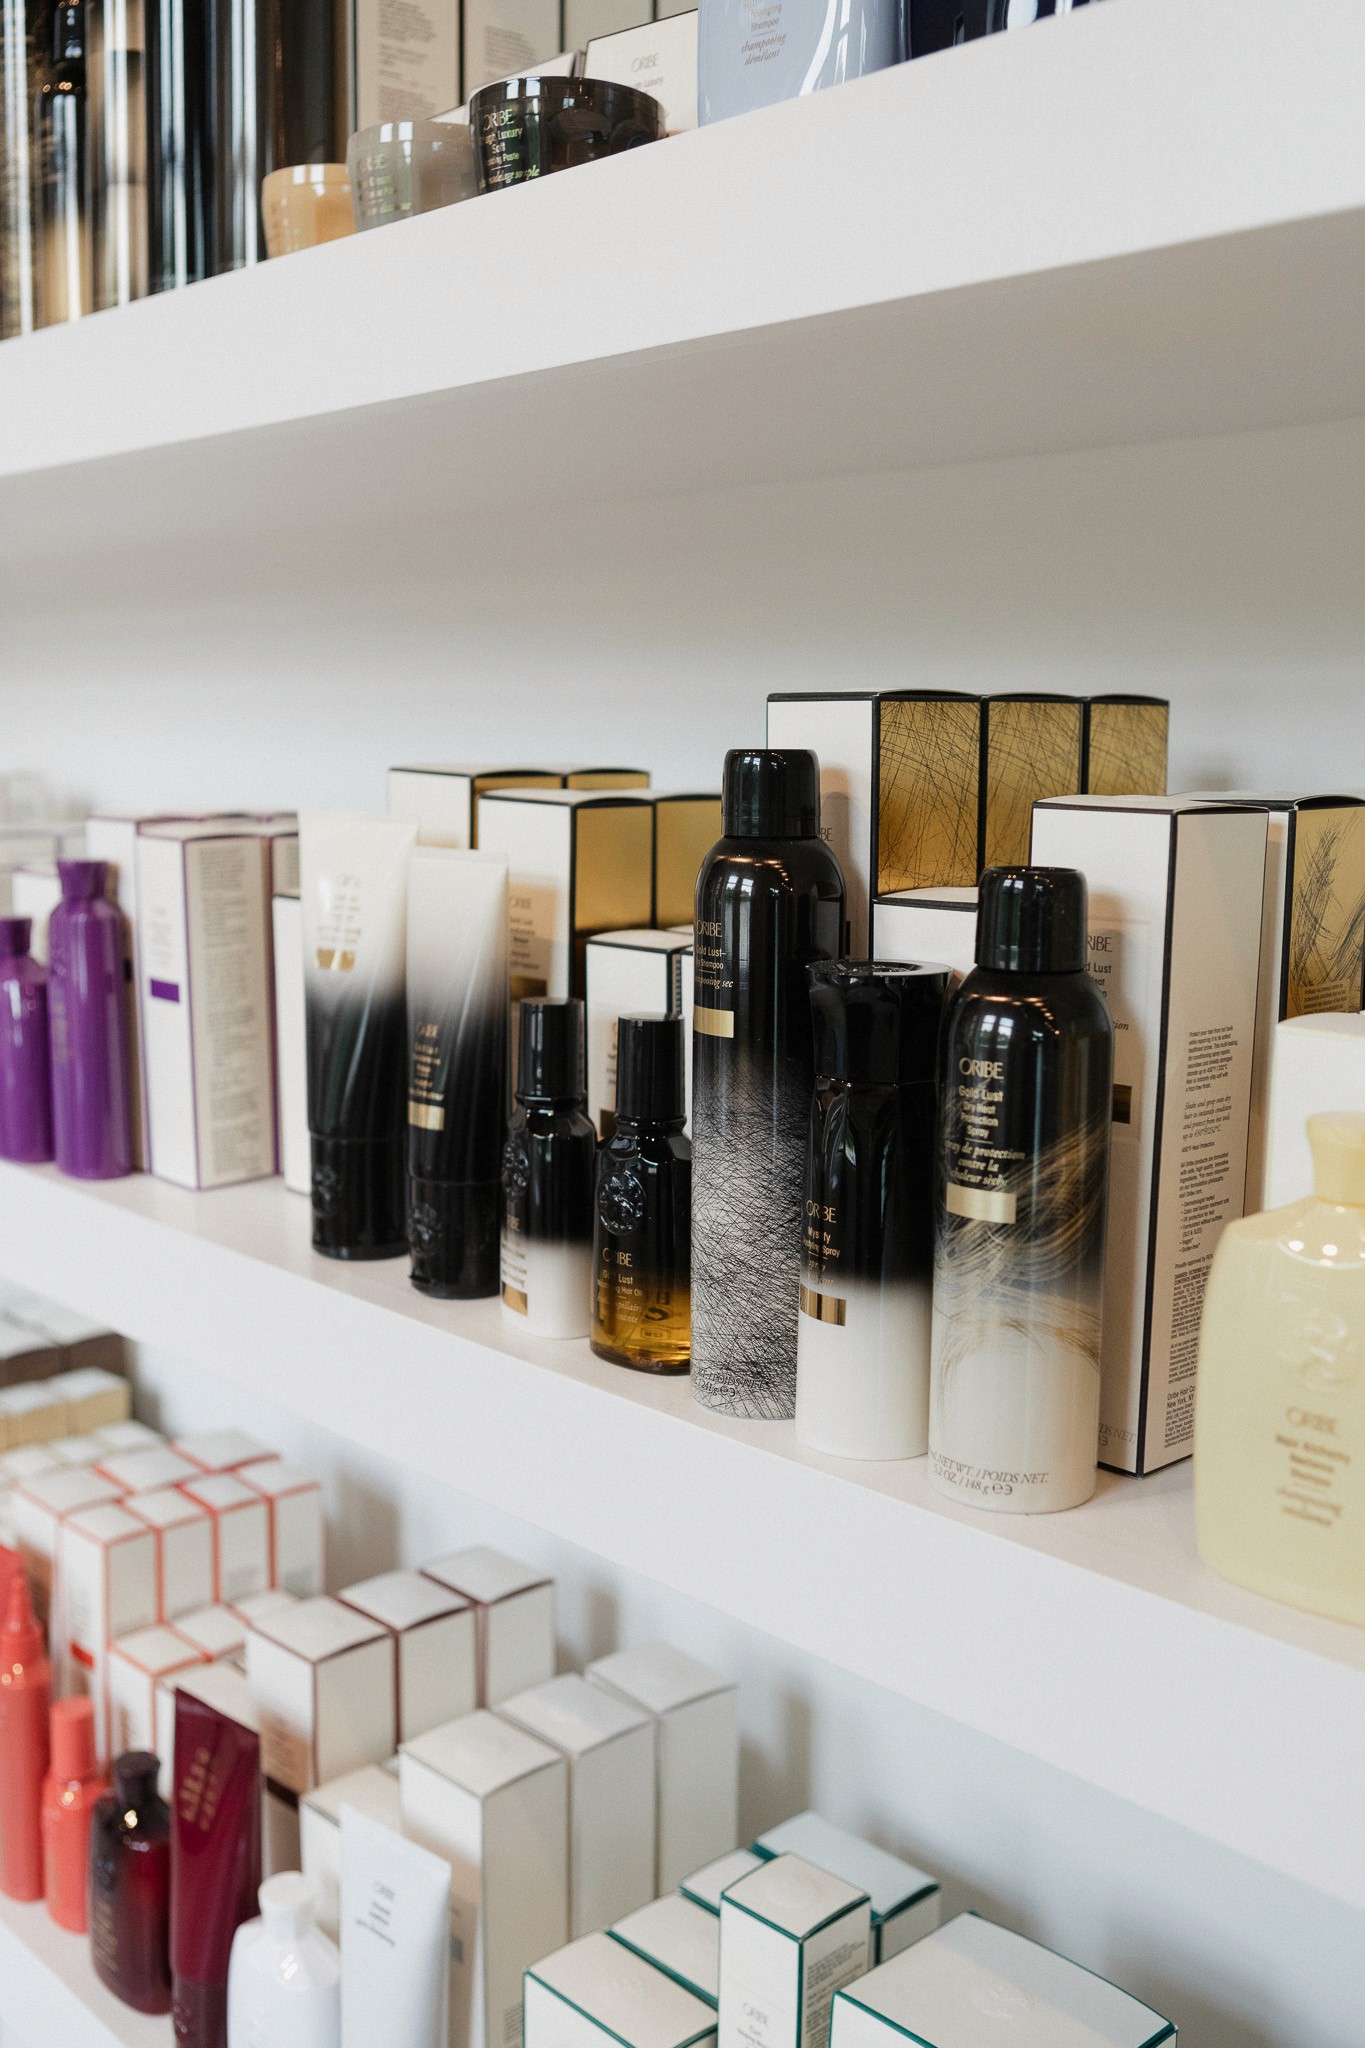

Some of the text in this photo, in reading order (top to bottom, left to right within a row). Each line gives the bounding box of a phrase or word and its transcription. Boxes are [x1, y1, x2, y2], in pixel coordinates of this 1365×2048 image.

[741, 33, 787, 53] shampooing
[697, 920, 723, 937] ORIBE
[1087, 935, 1113, 952] RIBE
[708, 947, 722, 957] Lust
[1094, 963, 1112, 973] Lust
[722, 980, 734, 988] sec
[959, 1057, 1004, 1079] ORIBE
[959, 1085, 1004, 1102] Gold Lust
[972, 1147, 1025, 1159] protection
[987, 1159, 999, 1172] la
[806, 1200, 836, 1223] ORBE
[808, 1226, 831, 1244] Mysfy
[823, 1245, 840, 1258] Spray
[618, 1274, 633, 1284] Lust
[1167, 1391, 1179, 1400] Oribe
[1167, 1401, 1176, 1409] New
[982, 1469, 1019, 1483] POIDS
[965, 1478, 981, 1490] 148
